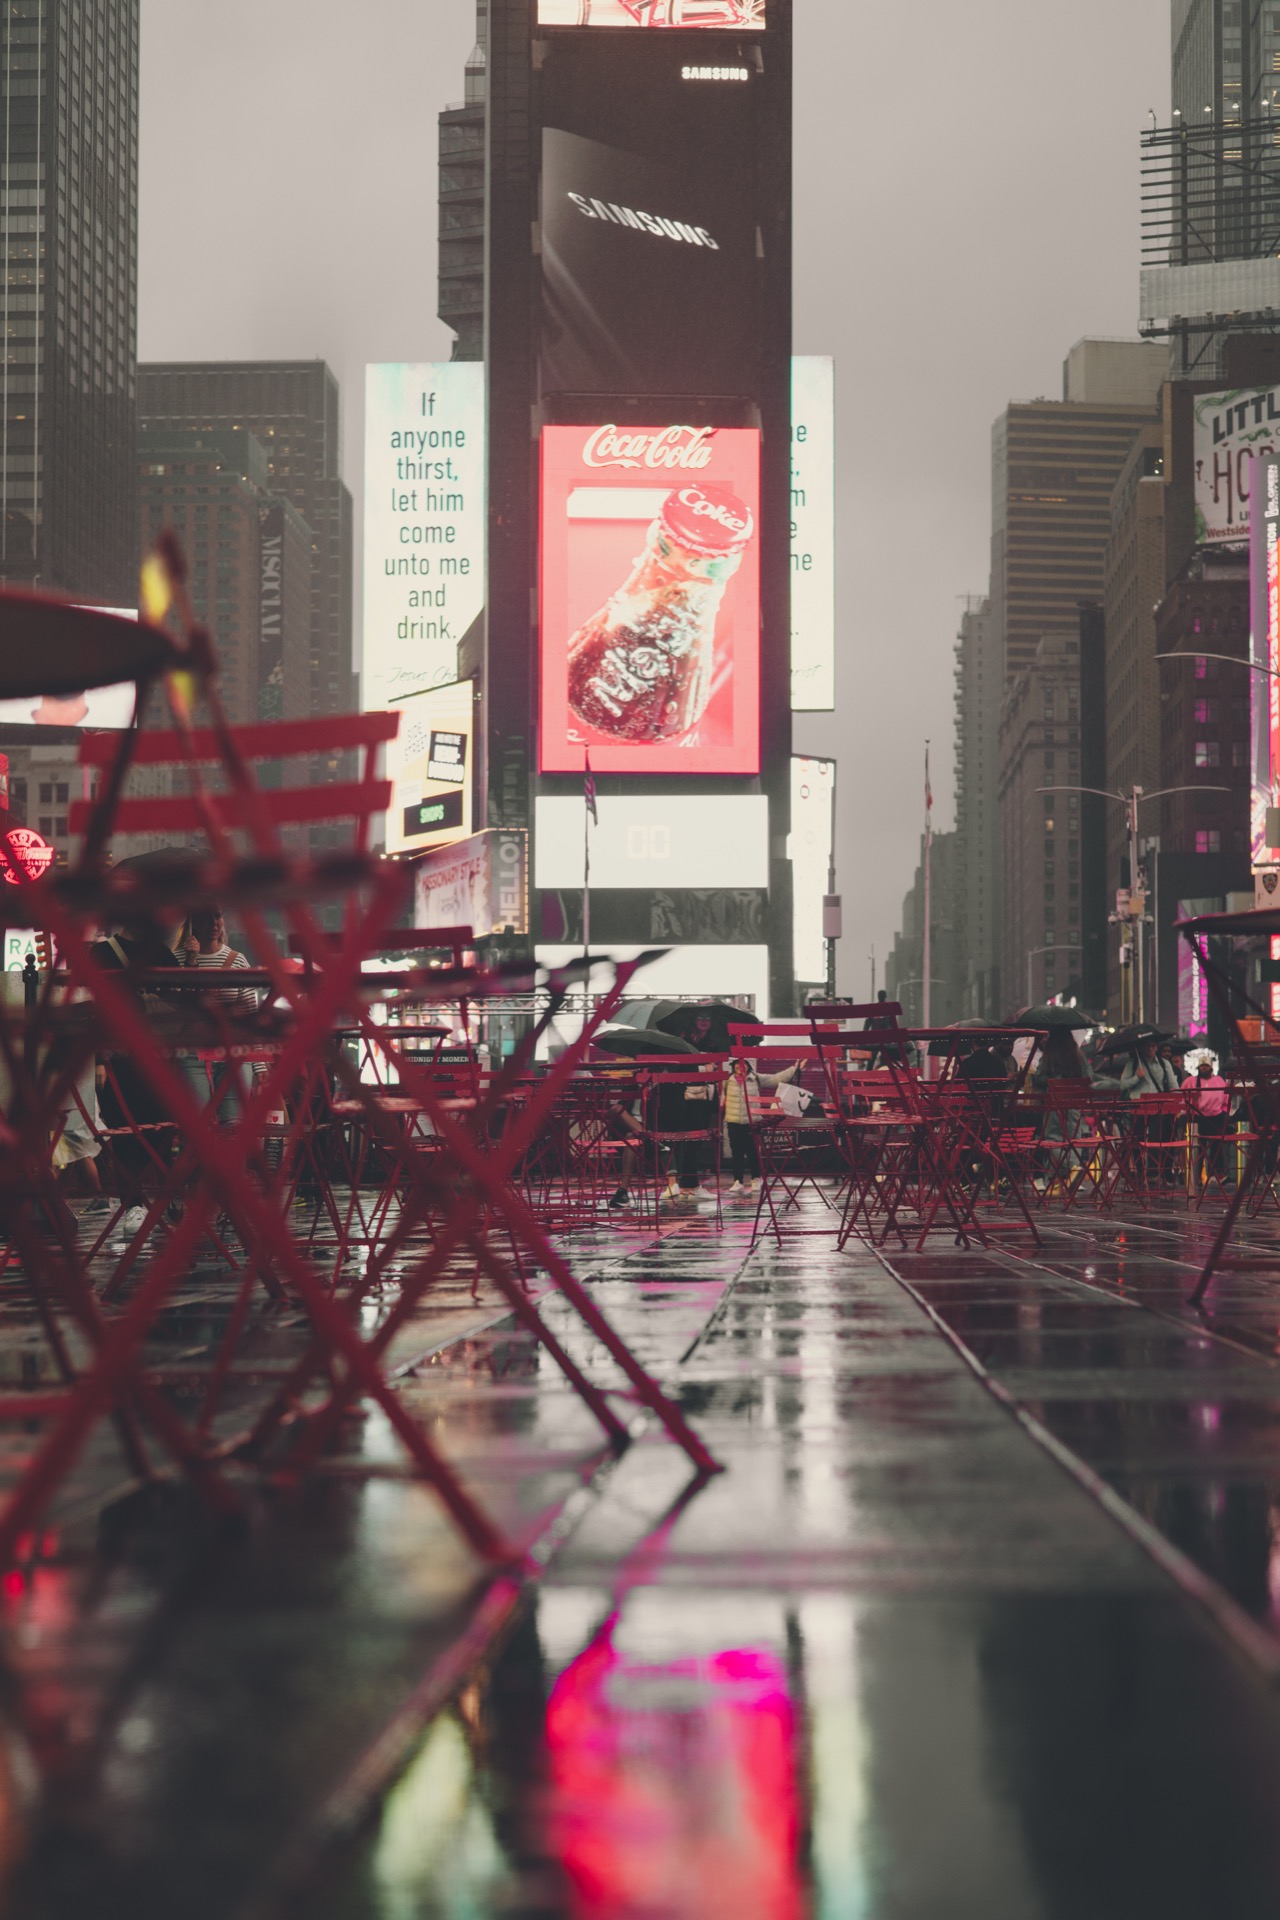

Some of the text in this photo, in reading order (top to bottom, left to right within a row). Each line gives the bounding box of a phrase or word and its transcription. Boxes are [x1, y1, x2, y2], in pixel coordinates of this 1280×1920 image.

[681, 66, 748, 81] SAMSUNG
[567, 191, 720, 250] SAMSUNG
[421, 392, 436, 416] If
[390, 429, 466, 455] anyone
[582, 424, 713, 469] Coca-Cola
[397, 457, 458, 481] thirst,
[391, 488, 464, 512] let him
[678, 488, 746, 532] Coke
[399, 525, 456, 544] come
[1206, 524, 1251, 538] Westside
[384, 553, 471, 576] unto me
[408, 583, 446, 608] and
[397, 615, 457, 640] drink.
[387, 667, 428, 683] Jesus
[499, 836, 520, 929] HELLO!
